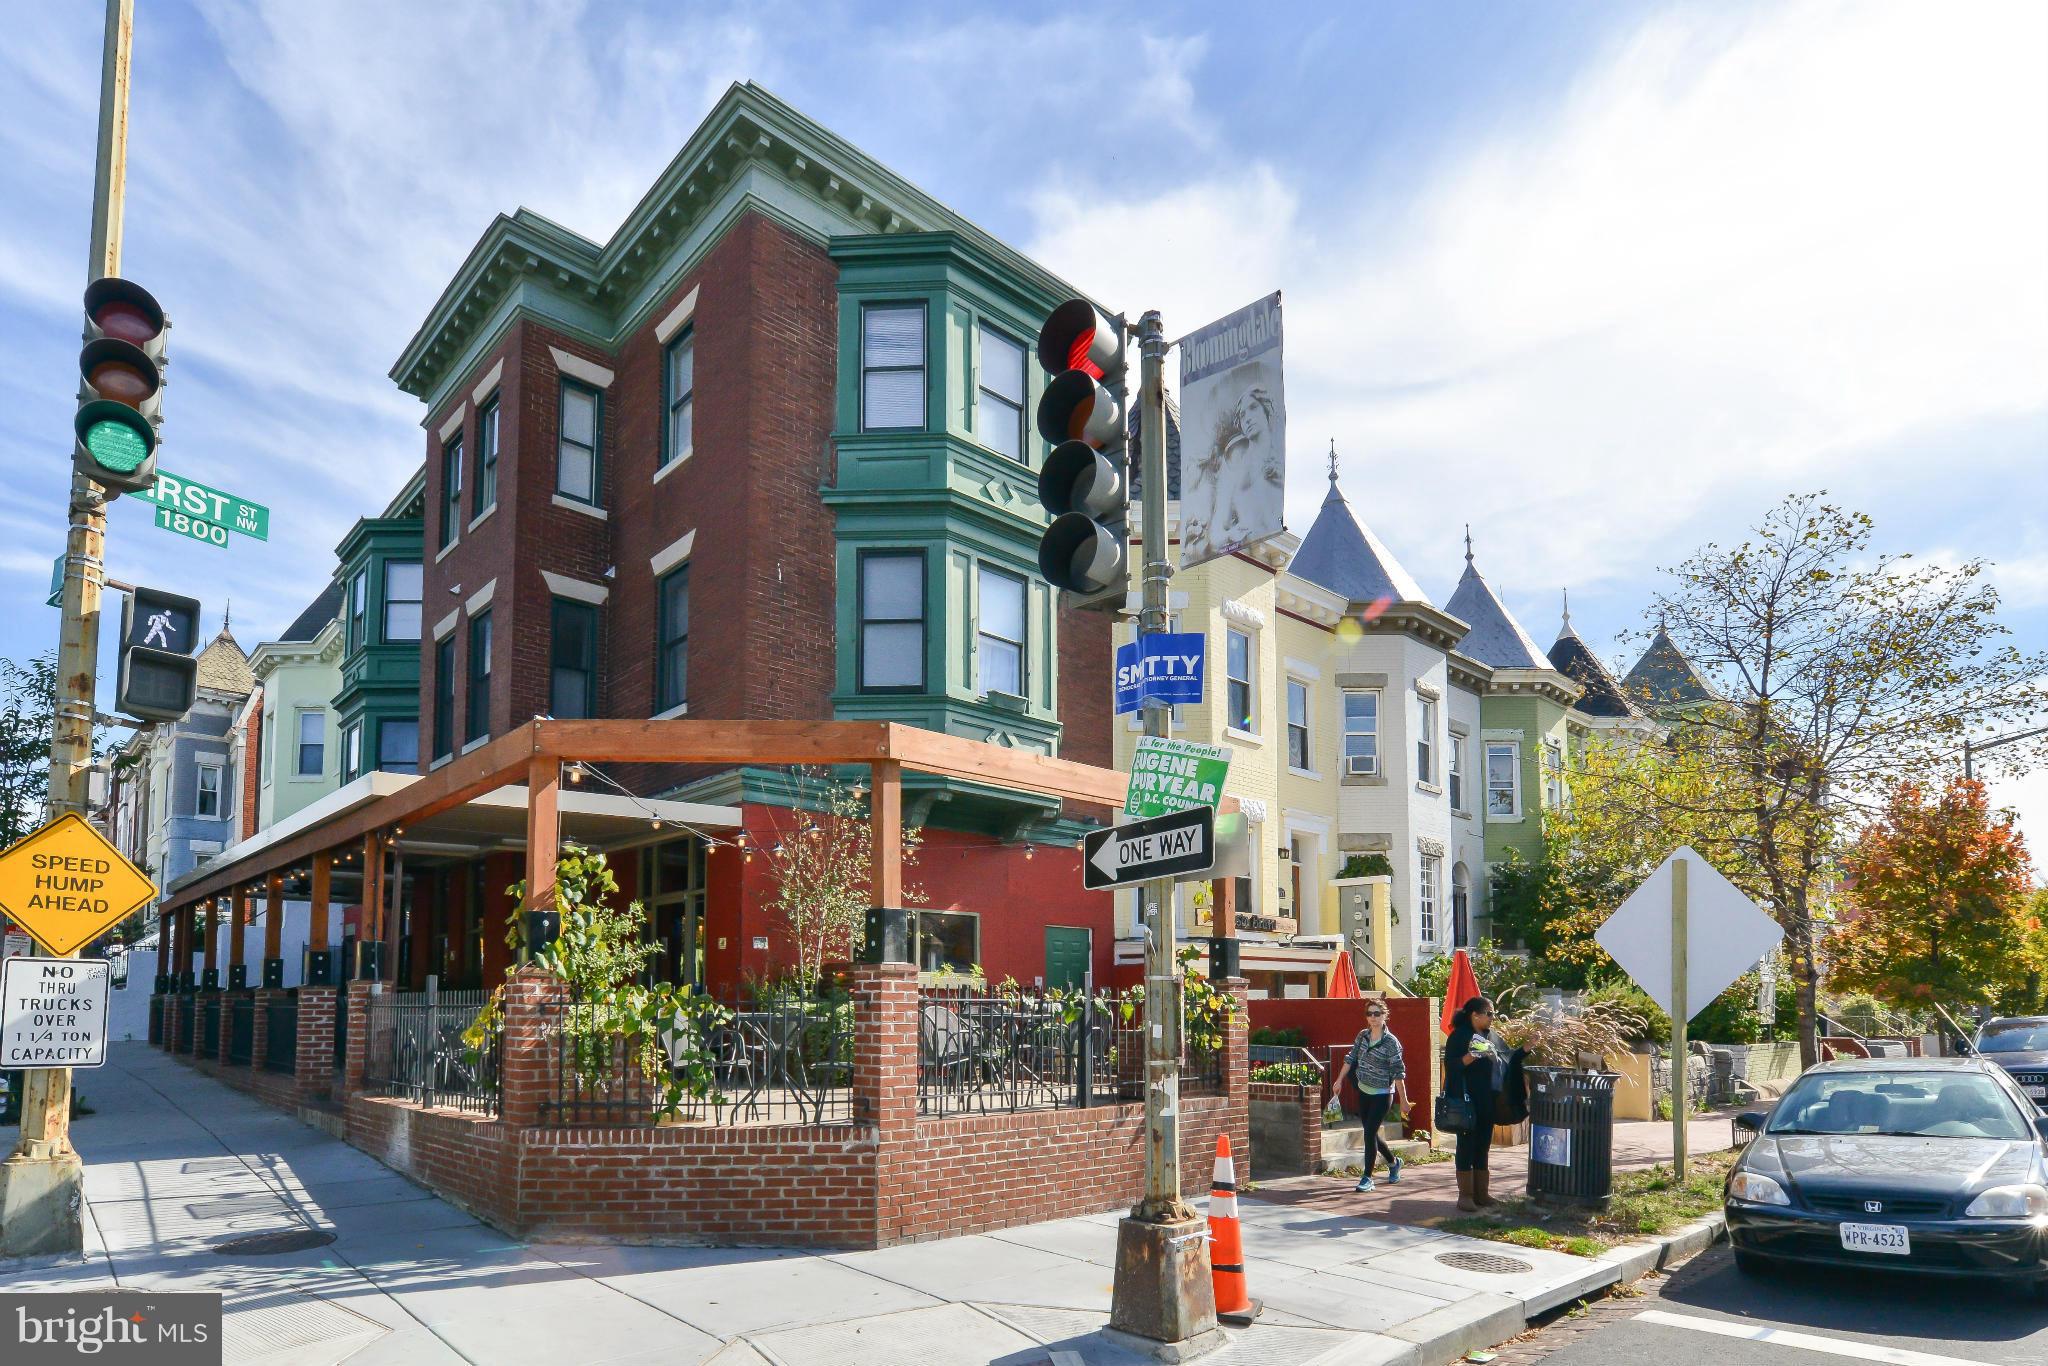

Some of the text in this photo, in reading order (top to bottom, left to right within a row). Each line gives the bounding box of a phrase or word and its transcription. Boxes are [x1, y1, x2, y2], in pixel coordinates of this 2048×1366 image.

[1183, 300, 1280, 376] Bloomingdale
[146, 475, 230, 521] RST
[239, 505, 258, 519] ST
[160, 509, 227, 545] 1800
[236, 517, 258, 532] NW
[1118, 655, 1200, 686] SMTTY
[1150, 738, 1165, 748] for
[1166, 741, 1182, 751] the
[1184, 744, 1222, 758] People!
[1134, 751, 1199, 778] EUGENE
[1131, 771, 1216, 803] PURYEAR
[1144, 792, 1208, 810] D.C. COUNC
[1120, 828, 1197, 865] ONE WAY
[31, 853, 111, 875] SPEED
[35, 874, 104, 893] HUMP
[27, 894, 109, 914] AHEAD
[42, 966, 74, 979] NO
[38, 981, 77, 995] THRU
[19, 997, 93, 1011] TRUCKS
[33, 1014, 76, 1027] OVER
[31, 1029, 52, 1044] 1/4
[62, 1031, 91, 1042] TON
[11, 1047, 93, 1061] CAPACITY
[1844, 1231, 1904, 1247] WPR-4523
